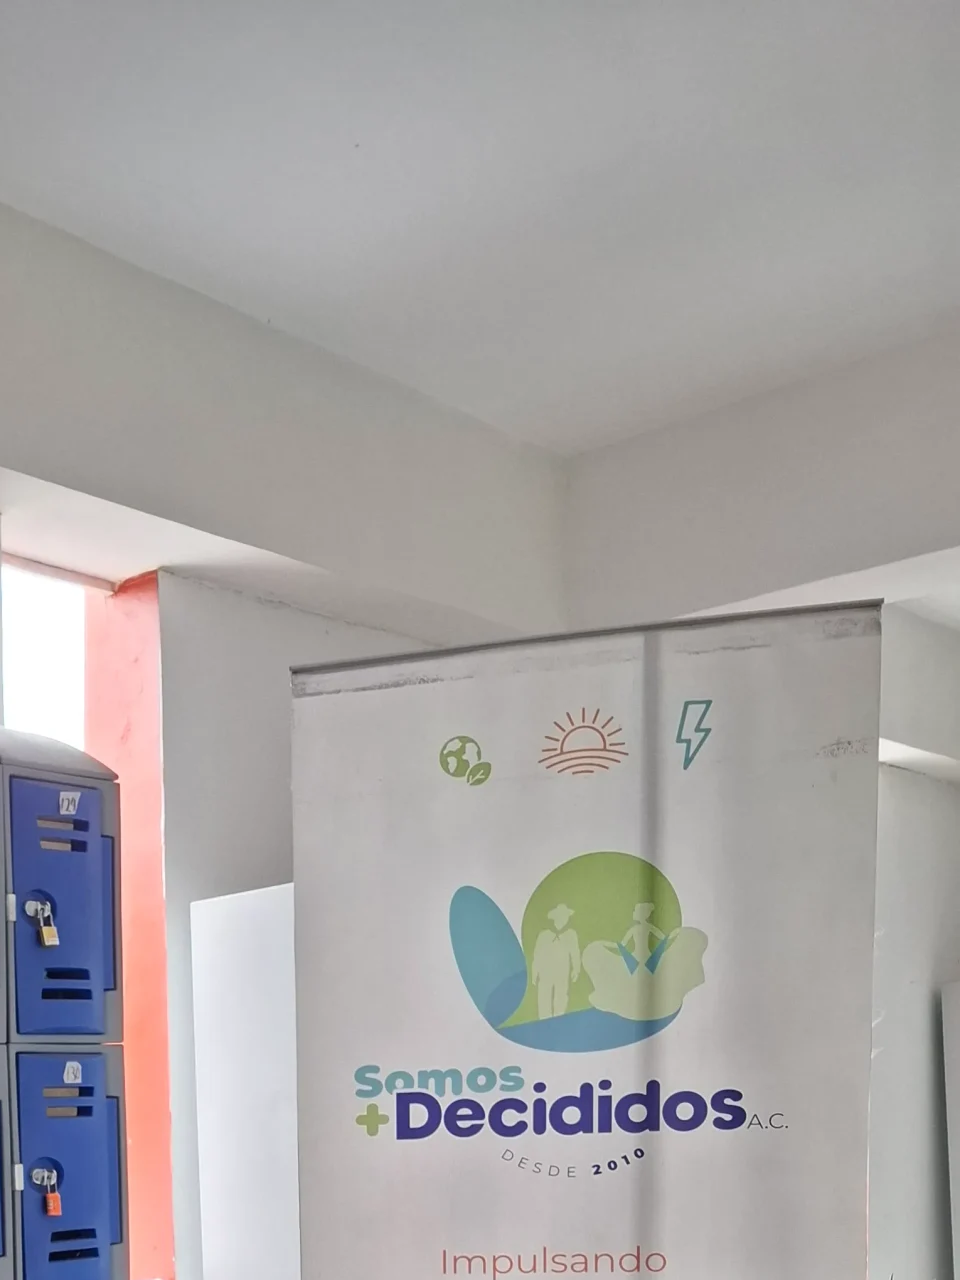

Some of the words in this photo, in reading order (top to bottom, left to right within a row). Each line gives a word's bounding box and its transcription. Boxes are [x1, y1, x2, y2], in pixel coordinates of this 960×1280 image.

[353, 1065, 525, 1098] Somos
[747, 1111, 789, 1130] A.C.
[501, 1149, 577, 1179] DESDE
[592, 1147, 647, 1176] 2010
[441, 1246, 667, 1280] Impulsando
